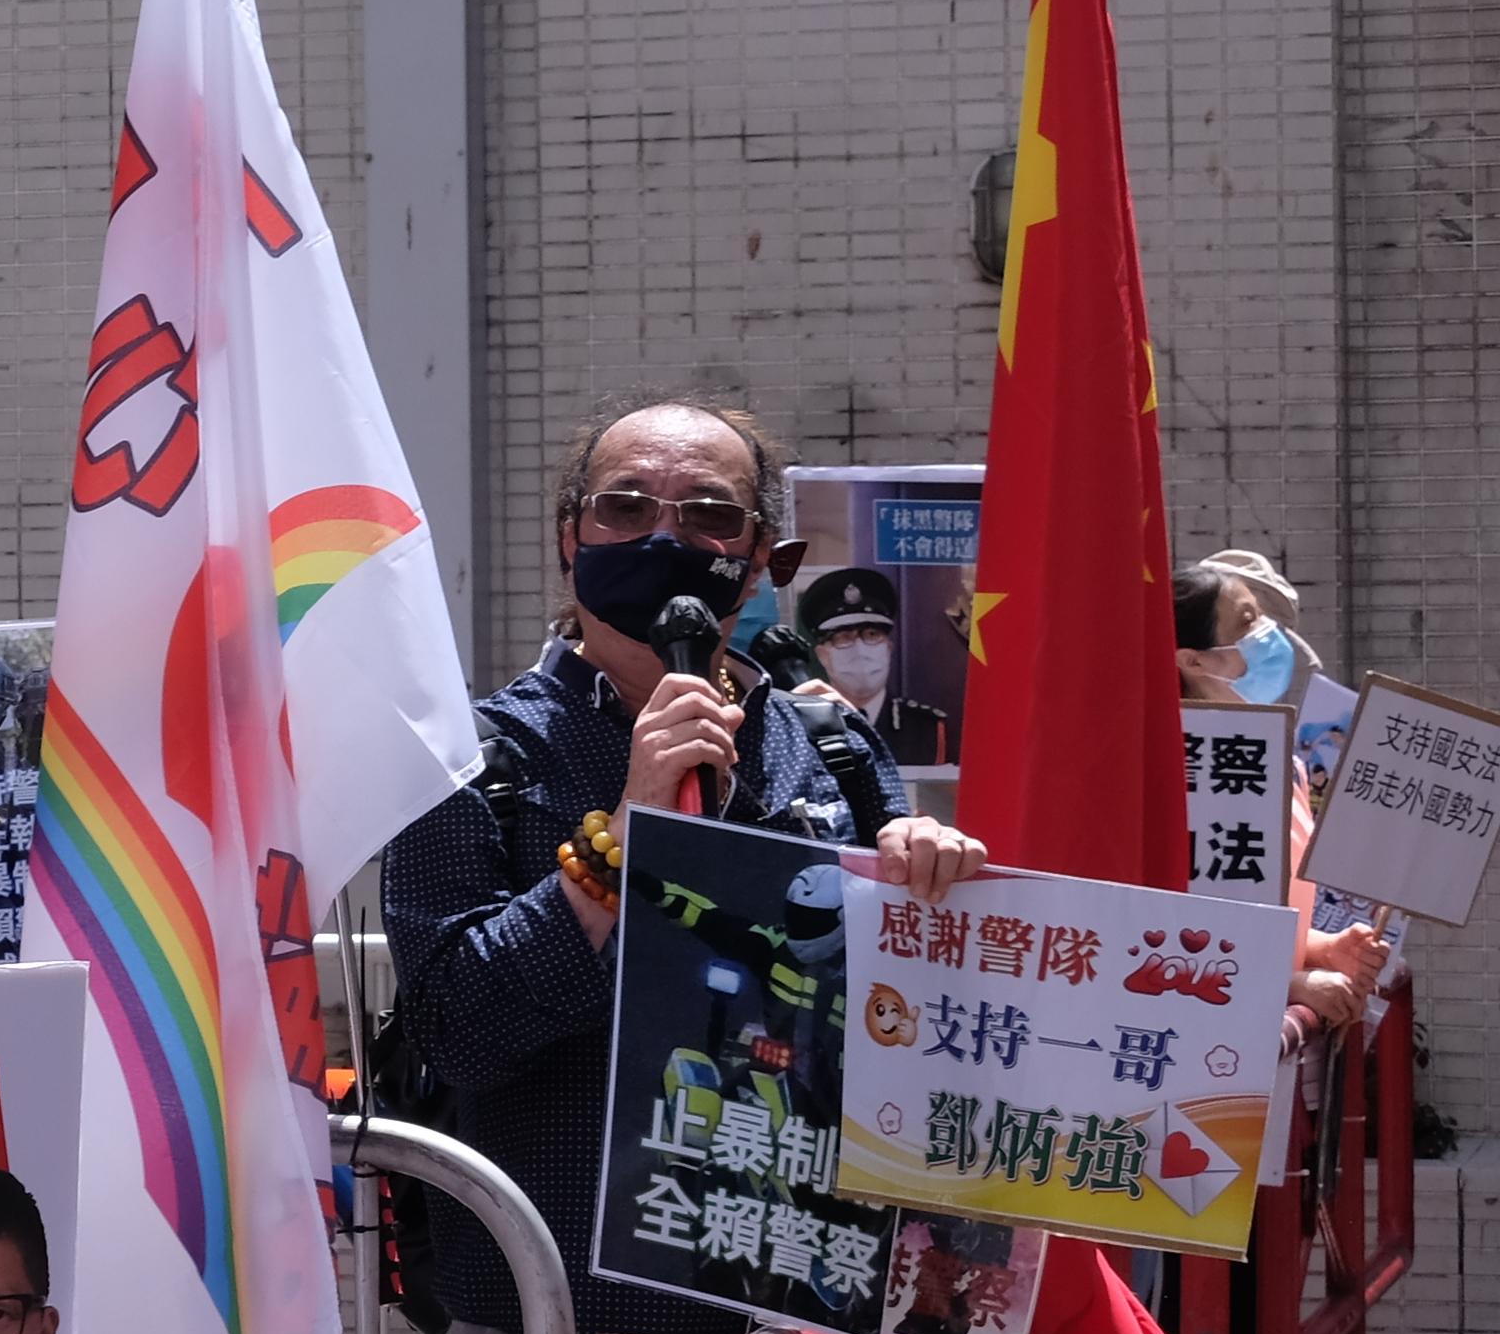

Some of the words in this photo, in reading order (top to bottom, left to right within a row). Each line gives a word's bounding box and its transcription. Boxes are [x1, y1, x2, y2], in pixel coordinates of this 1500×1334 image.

[1344, 759, 1496, 838] 踢走外國勢力
[877, 900, 1102, 986] 感謝警隊
[921, 993, 1178, 1091] 支持一哥
[641, 1088, 884, 1210] 止暴制
[924, 1089, 1150, 1201] 鄧炳強
[633, 1173, 880, 1299] 全賴警察
